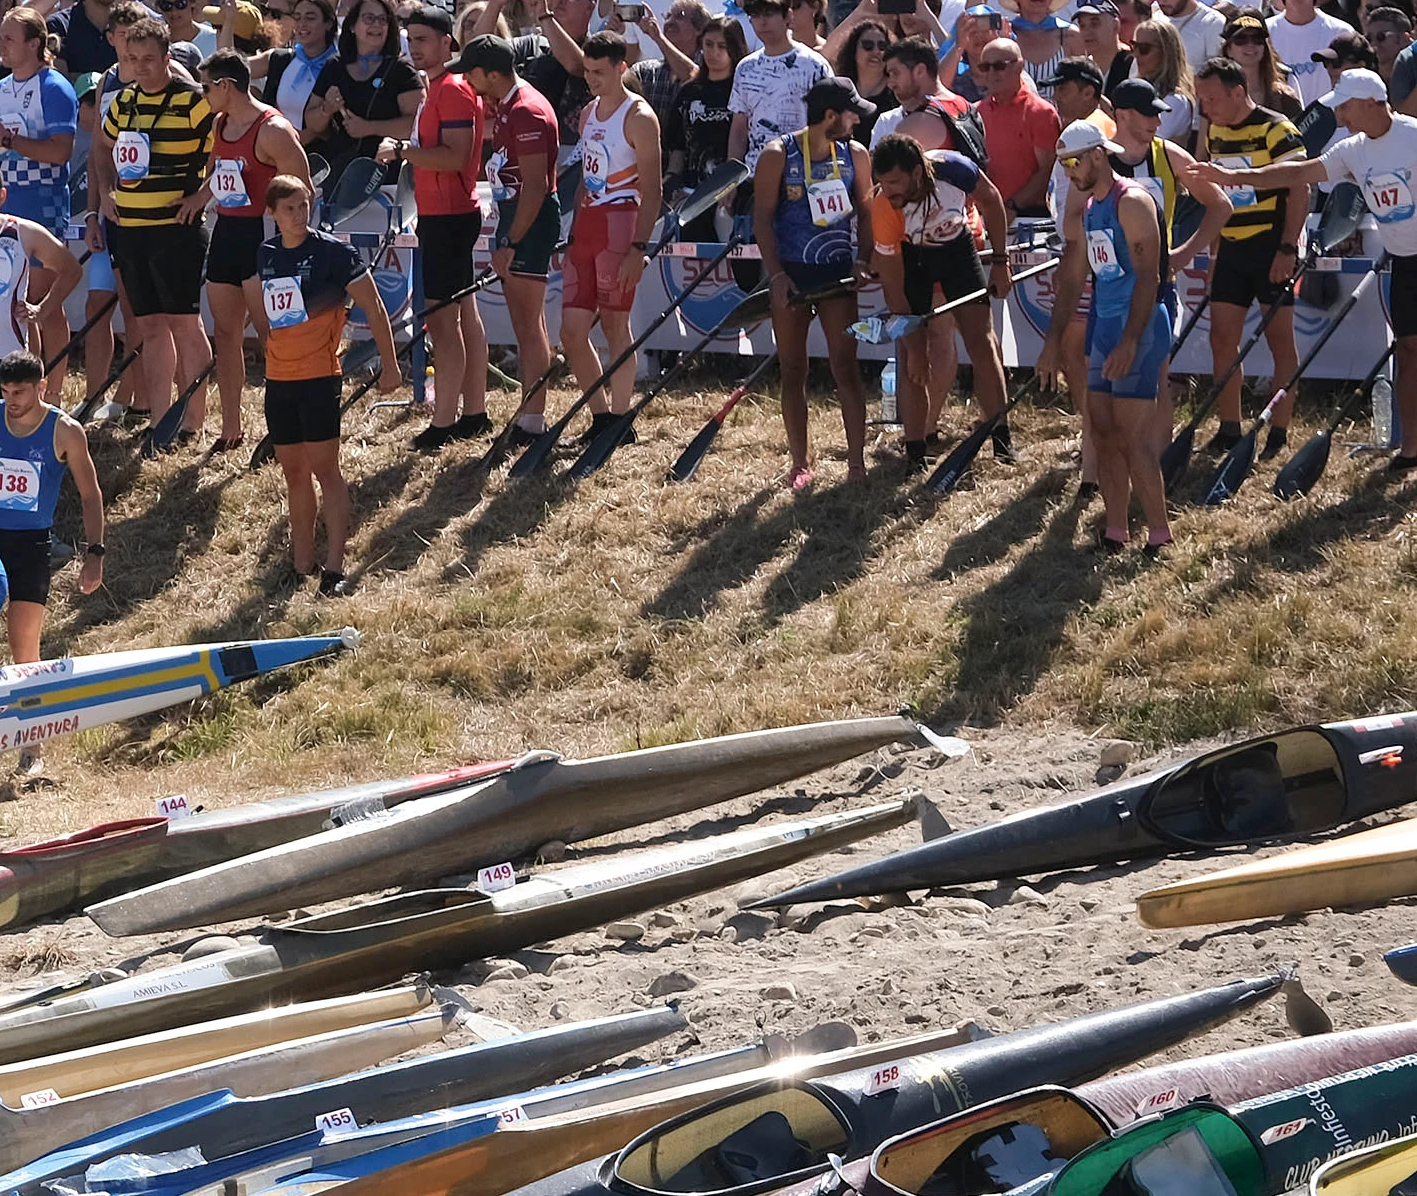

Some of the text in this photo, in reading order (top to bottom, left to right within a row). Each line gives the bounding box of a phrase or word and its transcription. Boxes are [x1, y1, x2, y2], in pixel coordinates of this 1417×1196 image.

[116, 145, 139, 164] 130
[216, 174, 238, 193] 132
[816, 194, 844, 215] 141
[1372, 188, 1398, 209] 147
[1015, 253, 1028, 264] 141
[1092, 246, 1109, 265] 146
[270, 291, 294, 312] 137
[13, 715, 80, 748] AVENTURA
[161, 797, 188, 814] 144
[484, 865, 512, 884] 149
[132, 984, 169, 999] AMIEVA
[874, 1066, 900, 1087] 158
[27, 1093, 56, 1107] 152
[1148, 1090, 1176, 1108] 160
[322, 1111, 352, 1130] 155
[501, 1108, 522, 1123] 57
[1275, 1122, 1302, 1137] 161
